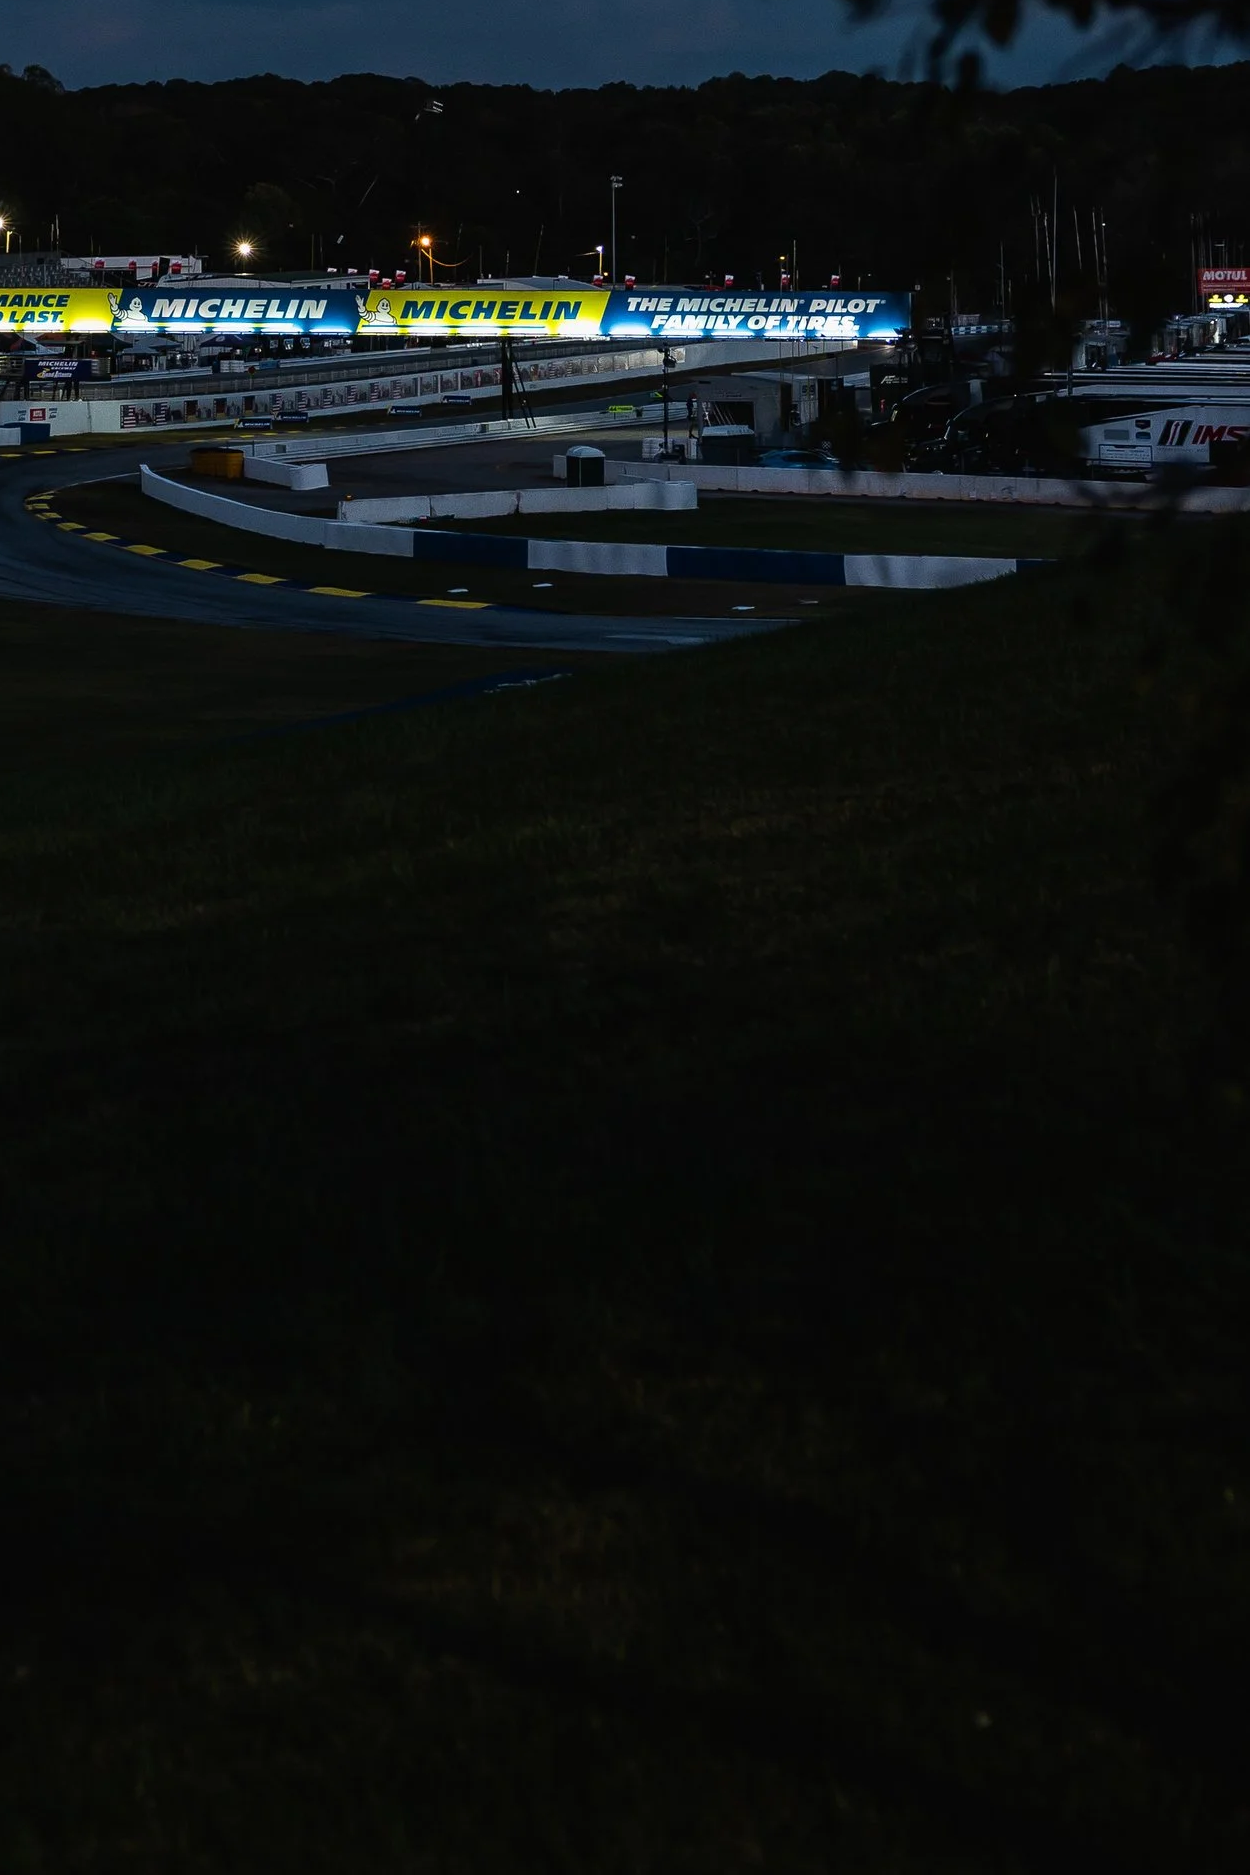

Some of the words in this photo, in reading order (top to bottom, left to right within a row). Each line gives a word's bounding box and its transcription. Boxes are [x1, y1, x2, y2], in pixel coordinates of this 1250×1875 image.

[1202, 270, 1247, 281] MOTUL
[151, 298, 327, 319] MICHELIN
[400, 300, 582, 320] MICHELIN
[627, 297, 674, 312] THE
[8, 310, 65, 323] LAST.
[651, 314, 745, 330] FAMILY
[747, 315, 783, 330] OF
[786, 315, 860, 331] TIRES.
